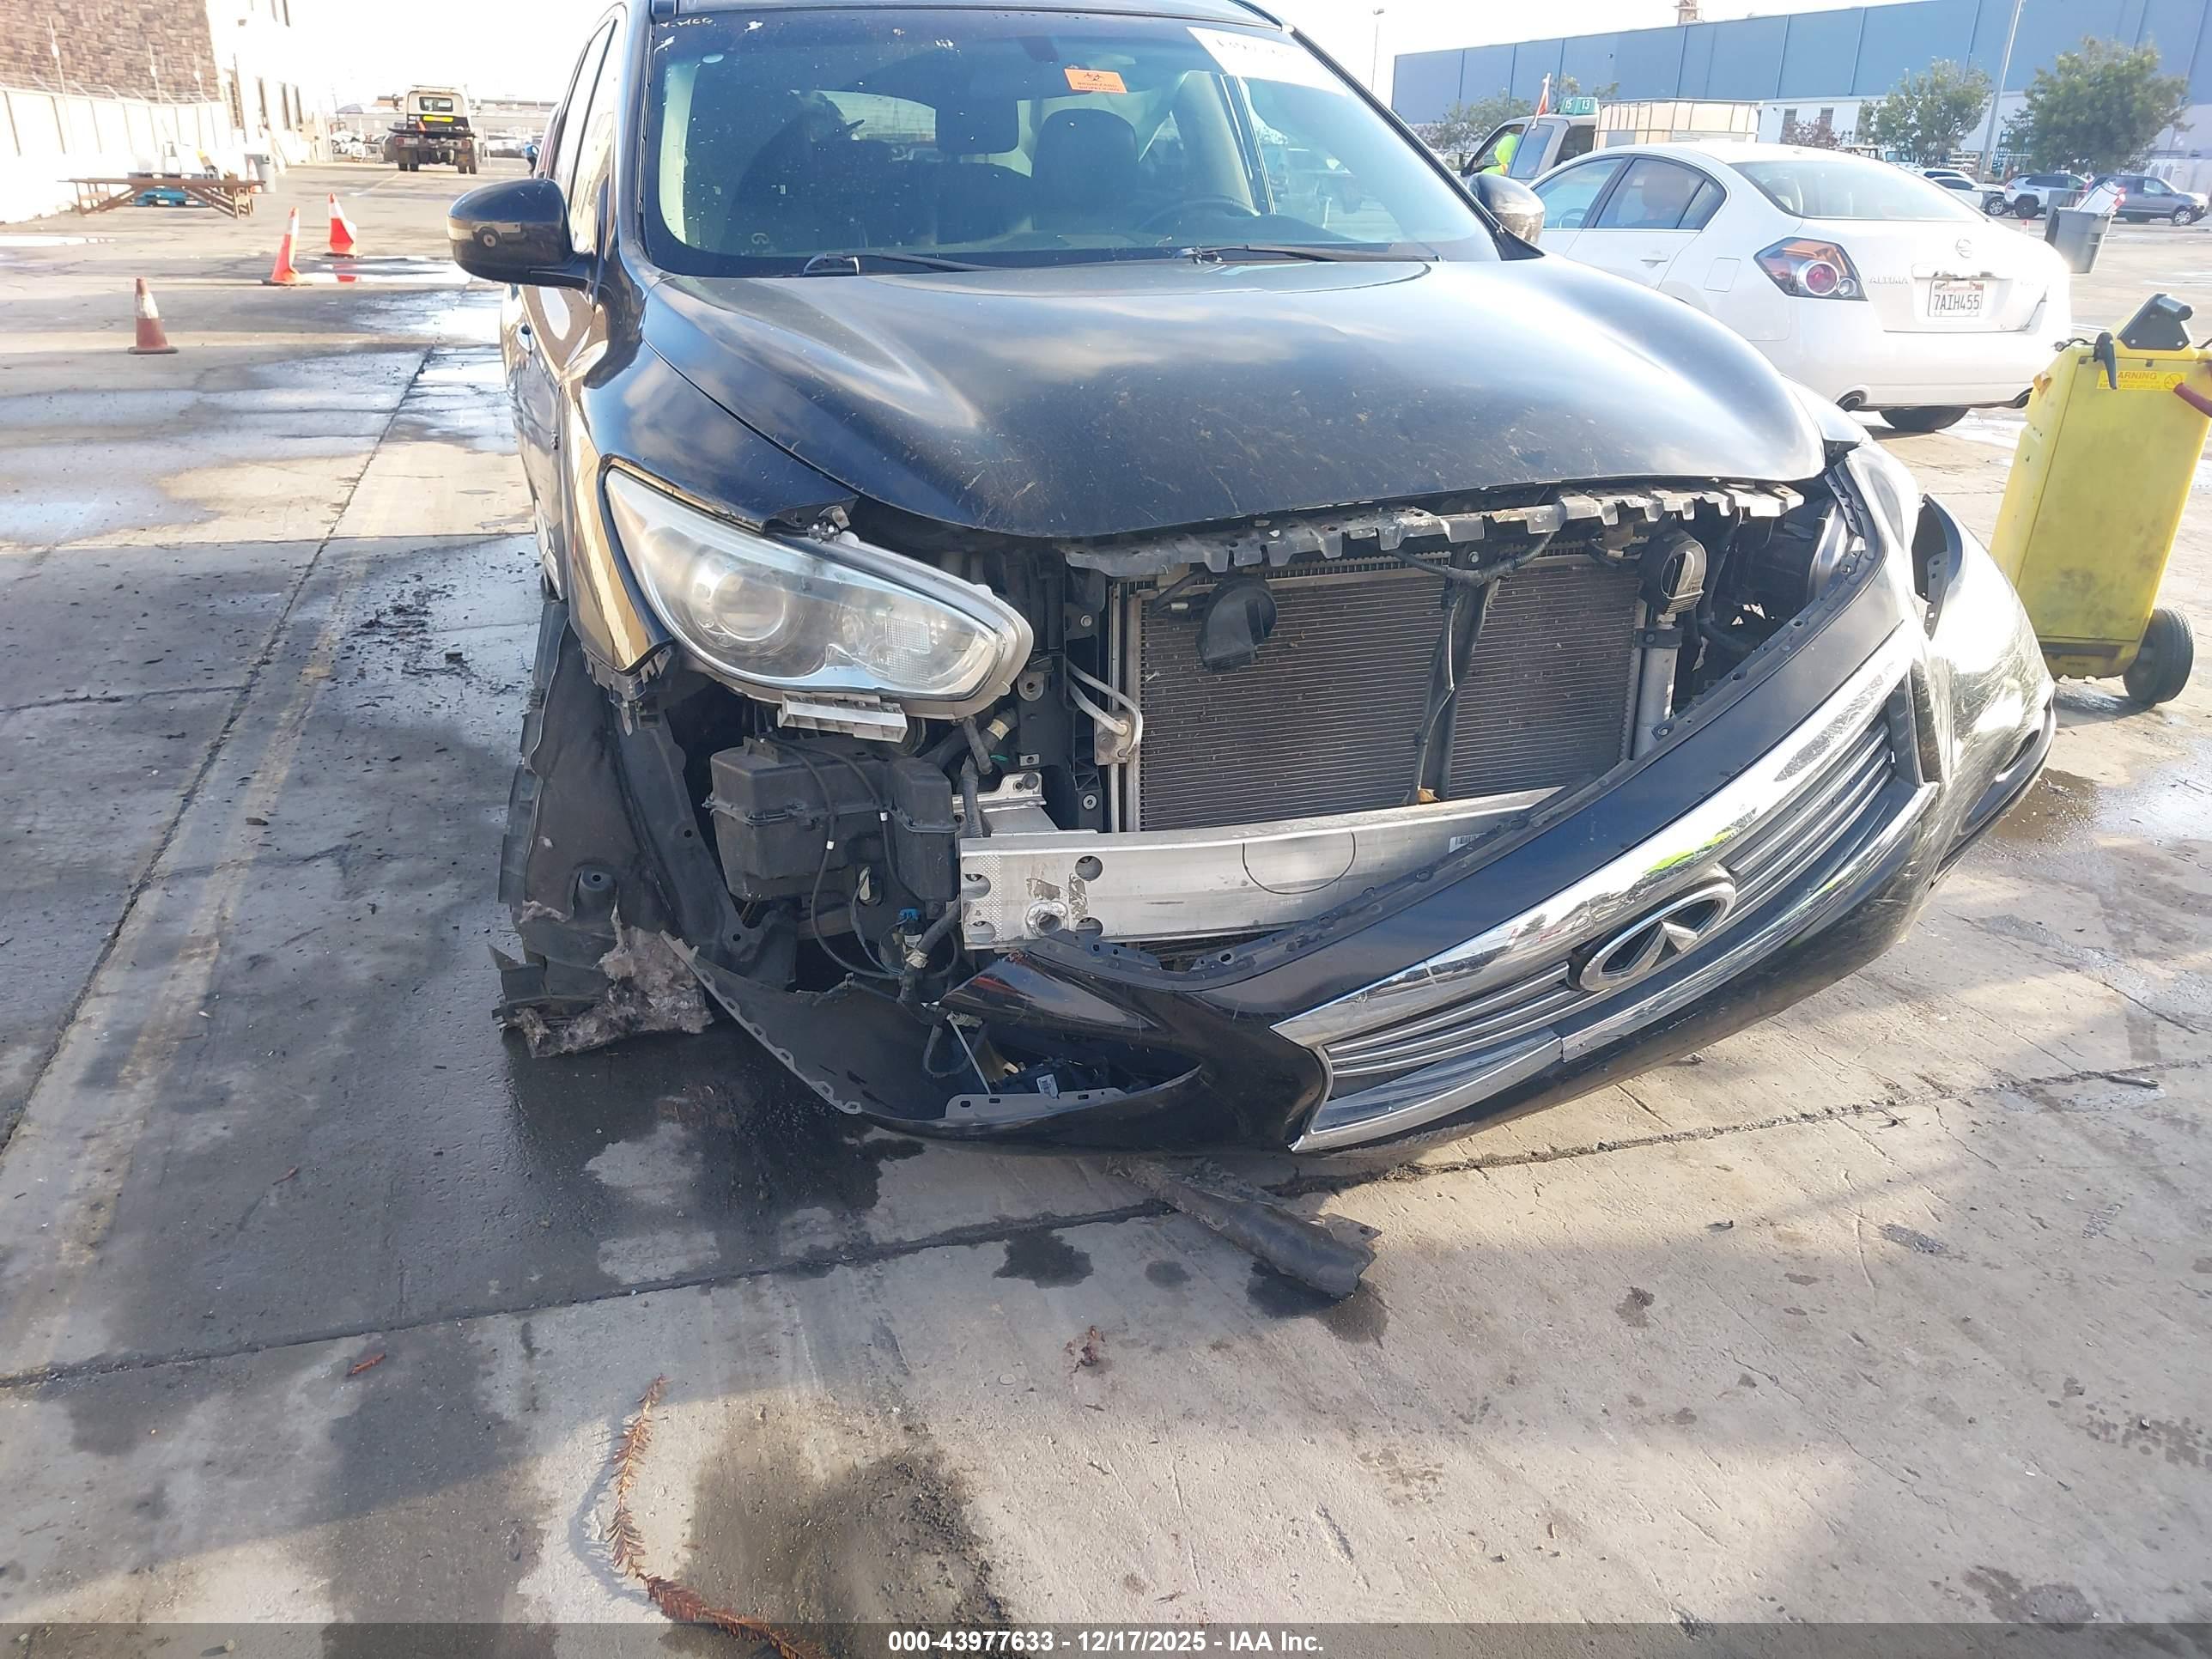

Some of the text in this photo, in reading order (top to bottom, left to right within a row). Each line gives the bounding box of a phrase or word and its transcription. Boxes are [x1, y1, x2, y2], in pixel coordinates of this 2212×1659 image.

[1581, 99, 1591, 110] 13
[1868, 275, 1909, 285] ALTIMA
[1934, 294, 1980, 311] 7AIH455
[2118, 371, 2158, 380] ARNING
